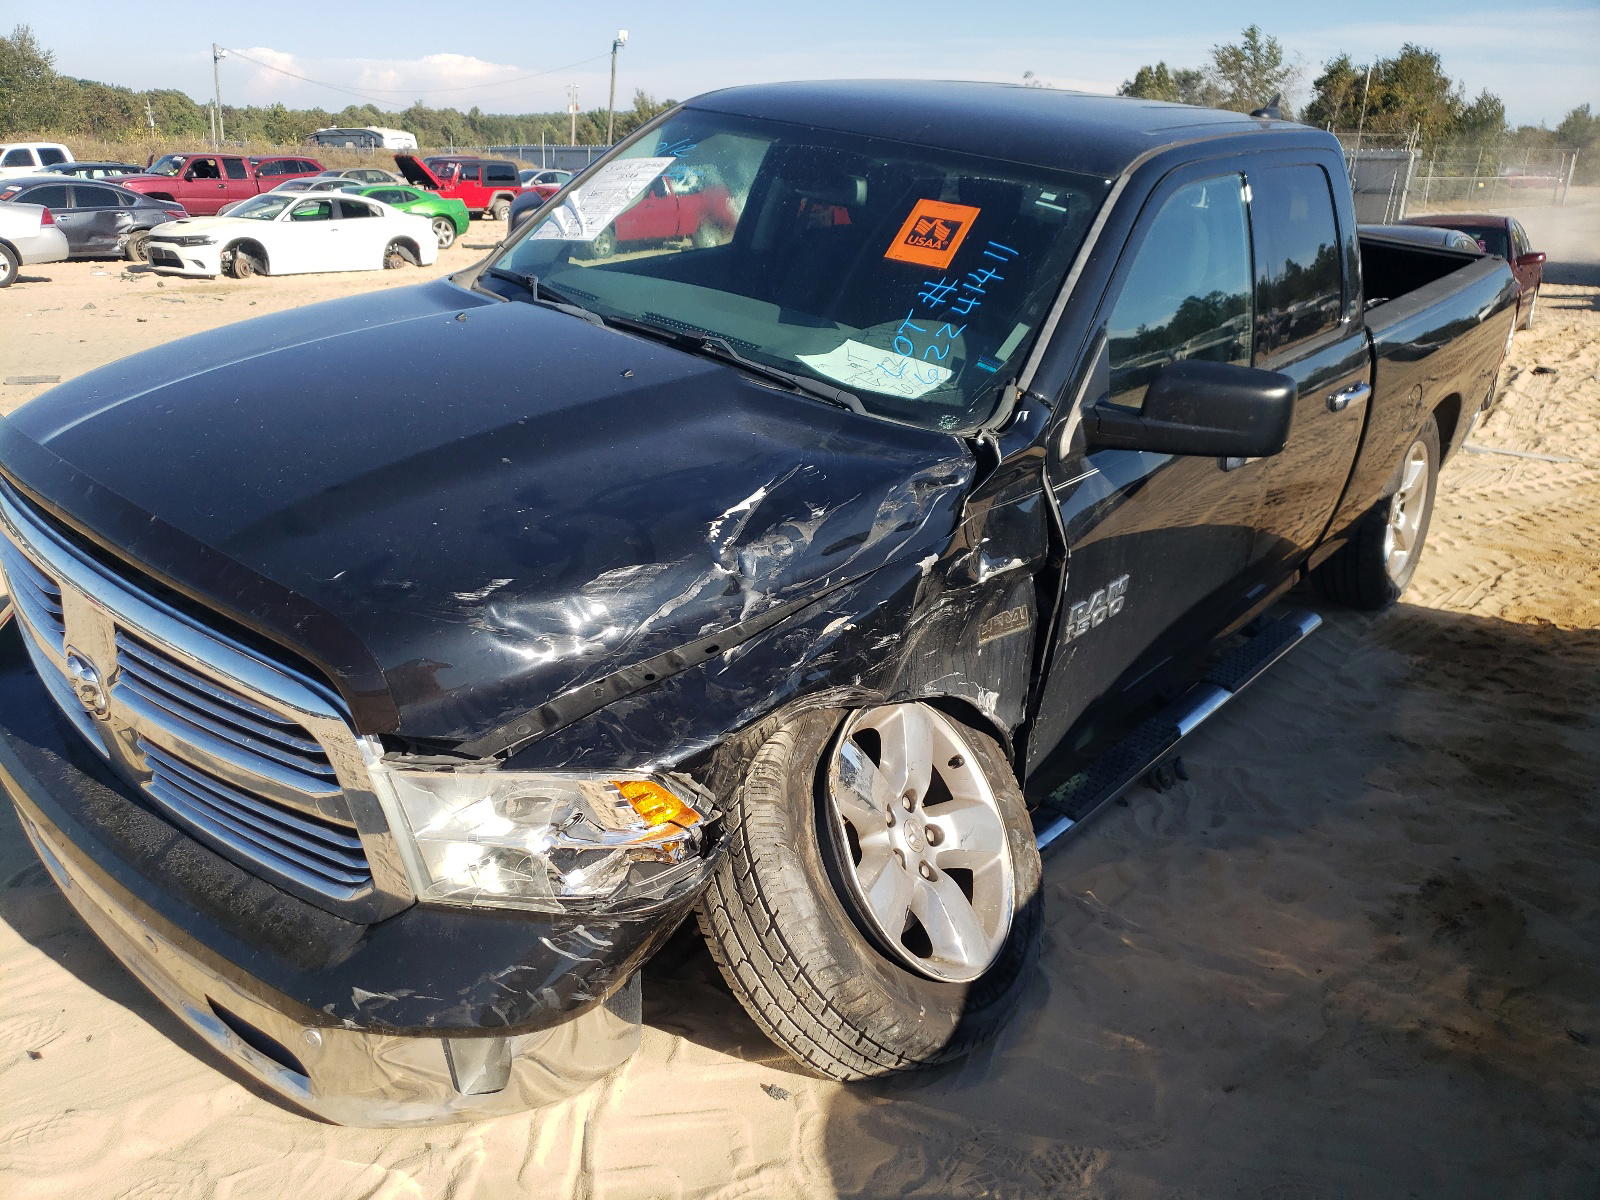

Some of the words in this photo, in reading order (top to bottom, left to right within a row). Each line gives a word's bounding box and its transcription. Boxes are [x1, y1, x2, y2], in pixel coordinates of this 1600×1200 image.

[907, 235, 943, 249] USAA
[1063, 595, 1125, 645] 1500
[1068, 573, 1130, 624] RAM
